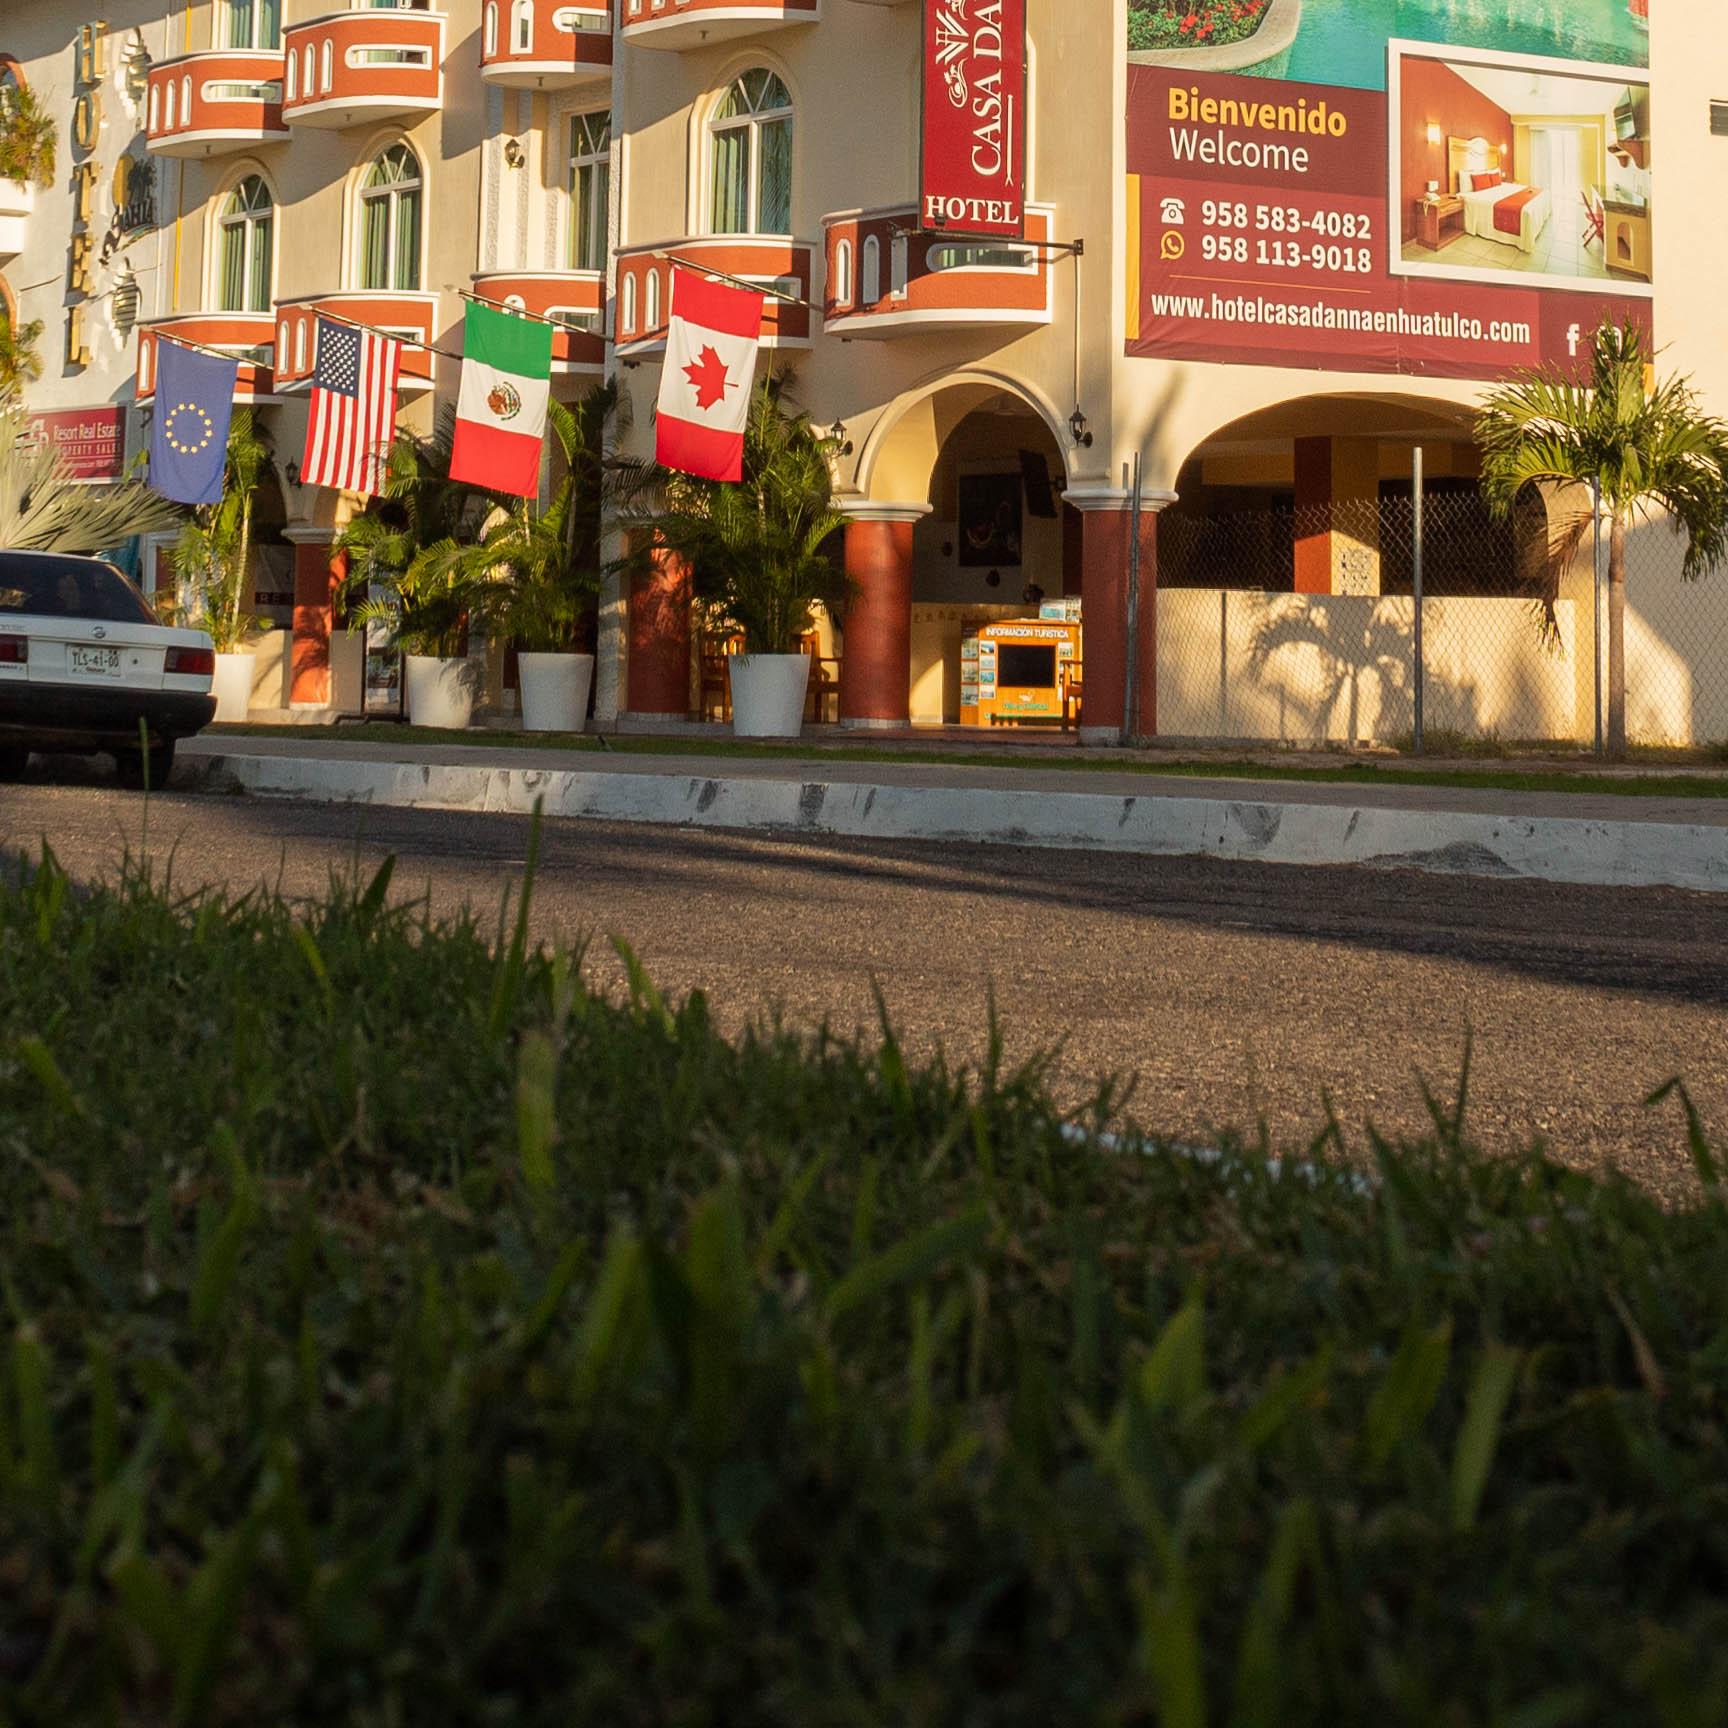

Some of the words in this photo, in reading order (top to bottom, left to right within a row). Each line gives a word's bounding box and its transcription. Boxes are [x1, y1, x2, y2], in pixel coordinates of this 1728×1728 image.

[971, 73, 1004, 176] CASA
[1169, 86, 1347, 137] Bienvenido
[1169, 127, 1309, 172] Welcome
[69, 20, 107, 365] HOTEL
[925, 195, 1020, 225] HOTEL
[1201, 200, 1248, 229] 958
[1255, 204, 1372, 240] 583-4082
[1201, 235, 1248, 263] 958
[1256, 239, 1372, 273] 113-9018
[1152, 293, 1530, 344] www.hotelcasadannaenhuatulco.com
[54, 425, 78, 441] Resort
[79, 423, 96, 440] Real
[97, 422, 121, 439] Estate
